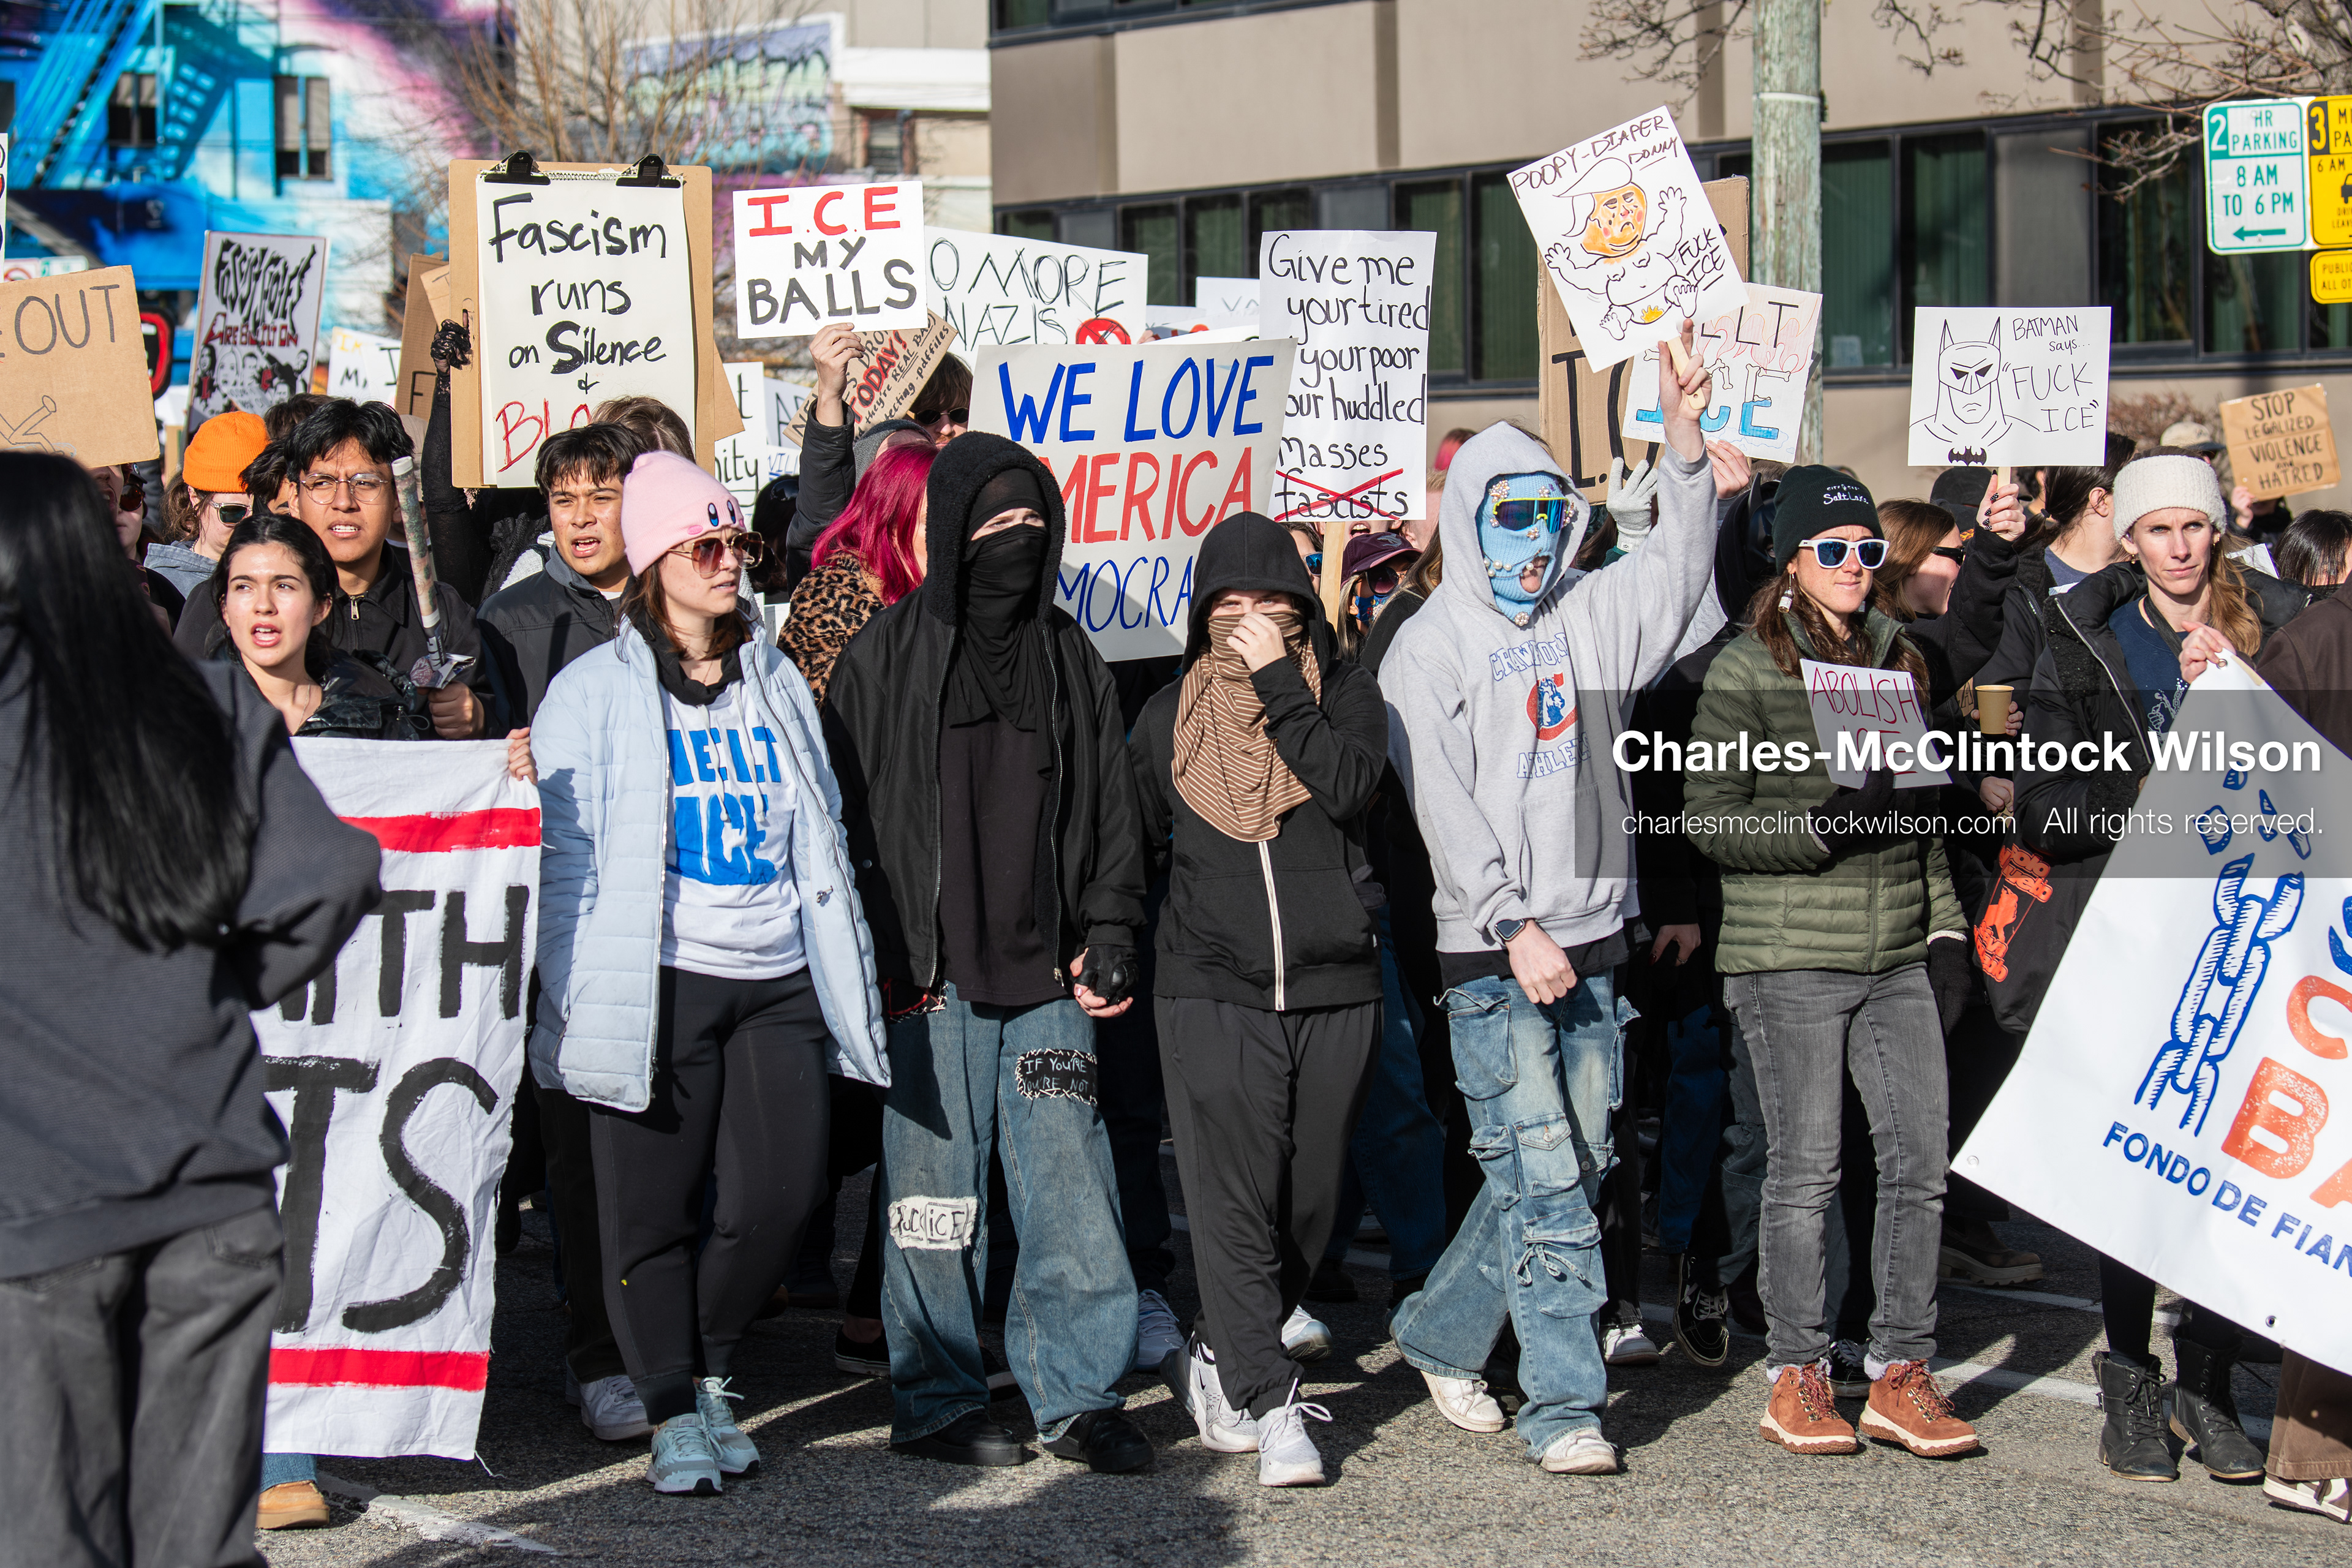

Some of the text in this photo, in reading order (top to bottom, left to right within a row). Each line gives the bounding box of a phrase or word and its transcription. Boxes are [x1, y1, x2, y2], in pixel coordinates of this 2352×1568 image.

[2209, 110, 2274, 151] 2 HR
[2231, 130, 2298, 152] PARKING
[2310, 106, 2327, 151] 3
[1629, 137, 1678, 164] DONNY
[2329, 158, 2346, 172] AM
[2237, 164, 2278, 187] 8 AM
[2222, 192, 2294, 216] TO 6 PM
[489, 193, 666, 263] Fascism
[1678, 227, 1717, 266] FUCK
[794, 236, 867, 270] MY
[1267, 233, 1415, 286] Give me
[1686, 245, 1725, 288] ICE
[530, 279, 631, 316] runs
[747, 258, 918, 326] BALLS
[967, 247, 1128, 318] MORE
[15, 284, 120, 355] OUT
[943, 295, 1068, 352] NAZIS
[1287, 284, 1431, 345] your tired
[2013, 315, 2079, 341] BATMAN
[508, 321, 667, 375] on Silence
[858, 330, 889, 369] DRO
[1300, 345, 1420, 388] your poor
[577, 372, 600, 394] &
[851, 330, 908, 424] TODAY!
[865, 383, 892, 424] they're
[891, 348, 916, 382] REAL
[998, 355, 1275, 444] WE LOVE
[1284, 373, 1427, 425] our huddled
[2250, 391, 2295, 421] STOP
[2244, 415, 2315, 441] LEGALIZED
[2248, 433, 2323, 464] VIOLENCE
[1039, 446, 1252, 544] MERICA
[1274, 467, 1409, 522] fascists
[2258, 462, 2324, 490] HATRED
[1823, 492, 1850, 505] Salt
[1811, 666, 1921, 724] ABOLISH
[1024, 1058, 1044, 1074] IF
[2102, 1121, 2212, 1196] FONDO
[2212, 1180, 2267, 1227] DE
